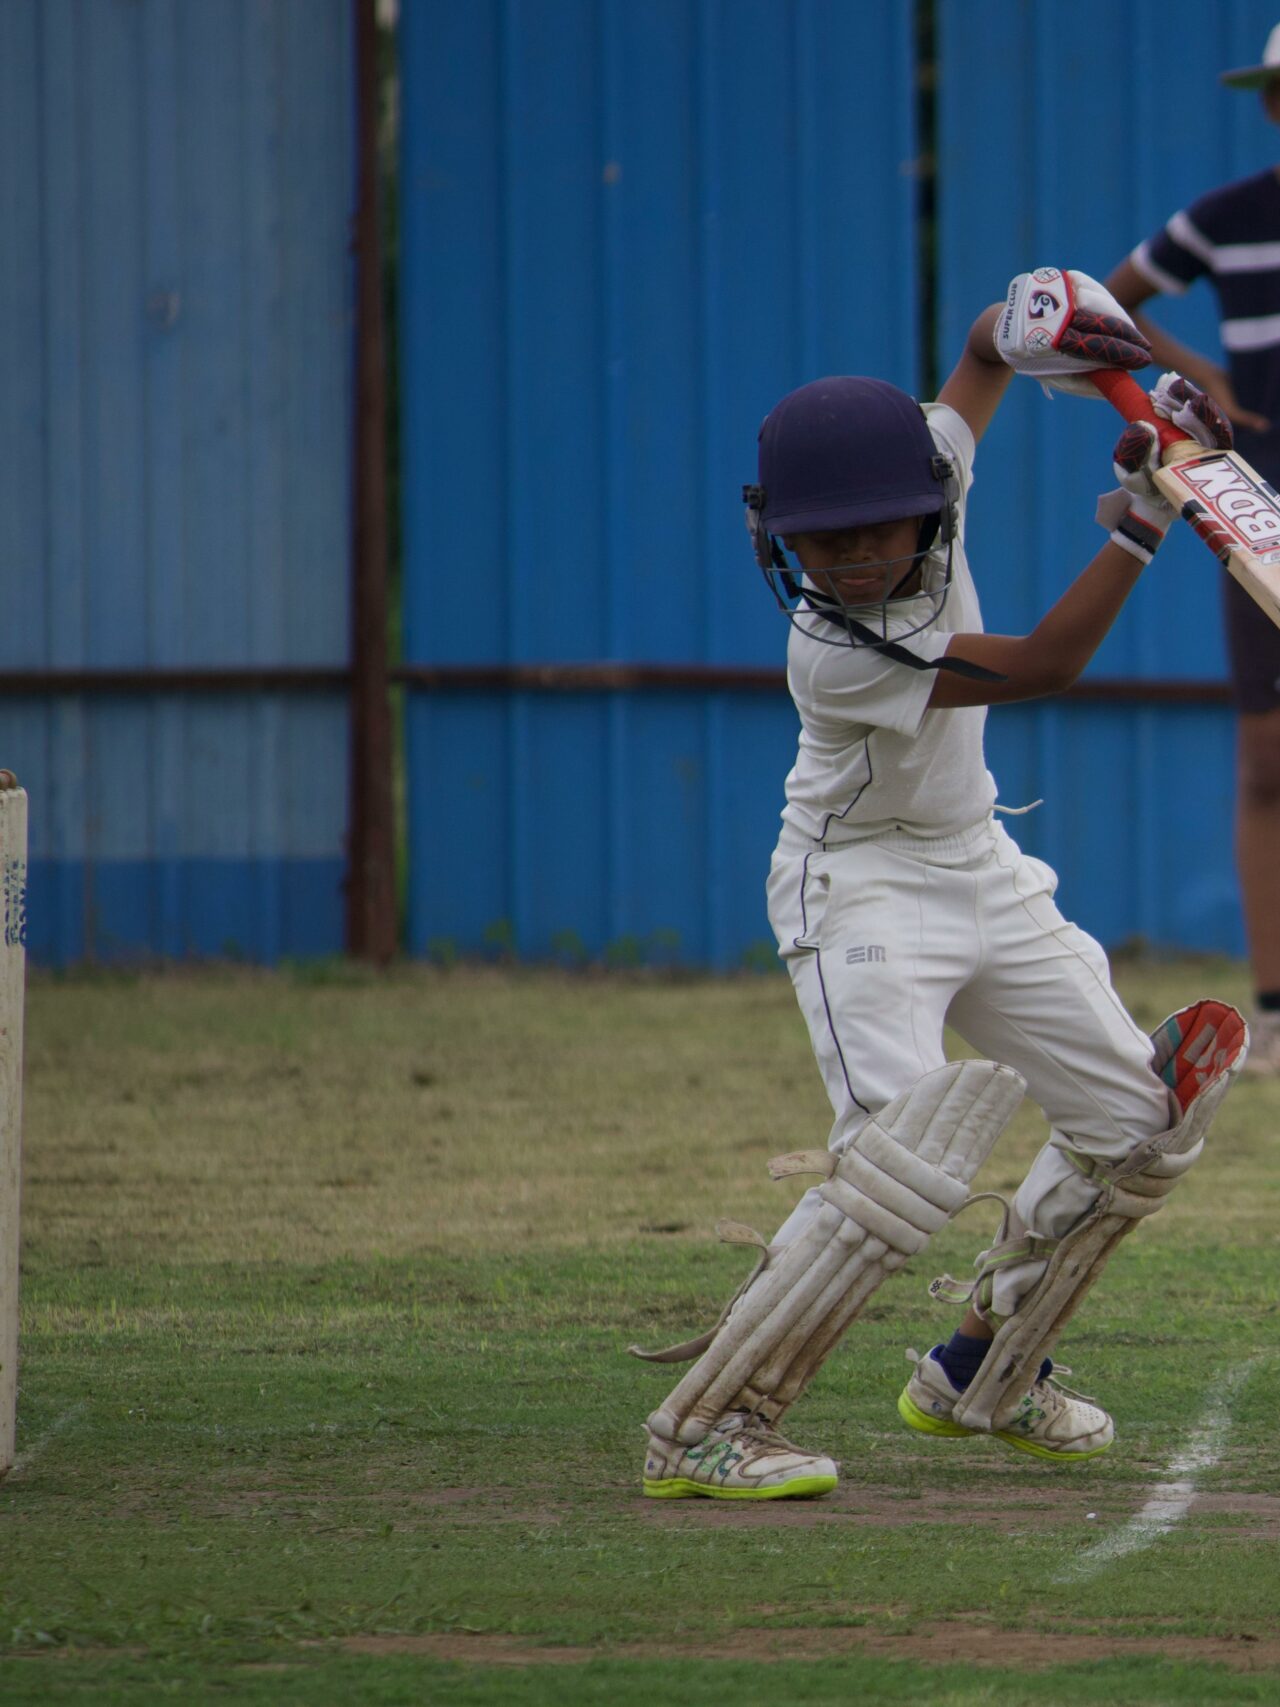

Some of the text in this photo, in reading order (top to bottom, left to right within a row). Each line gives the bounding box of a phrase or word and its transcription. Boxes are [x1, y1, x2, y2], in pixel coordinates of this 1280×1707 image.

[1003, 283, 1017, 339] SUPER CLUB
[930, 1279, 942, 1293] DSC
